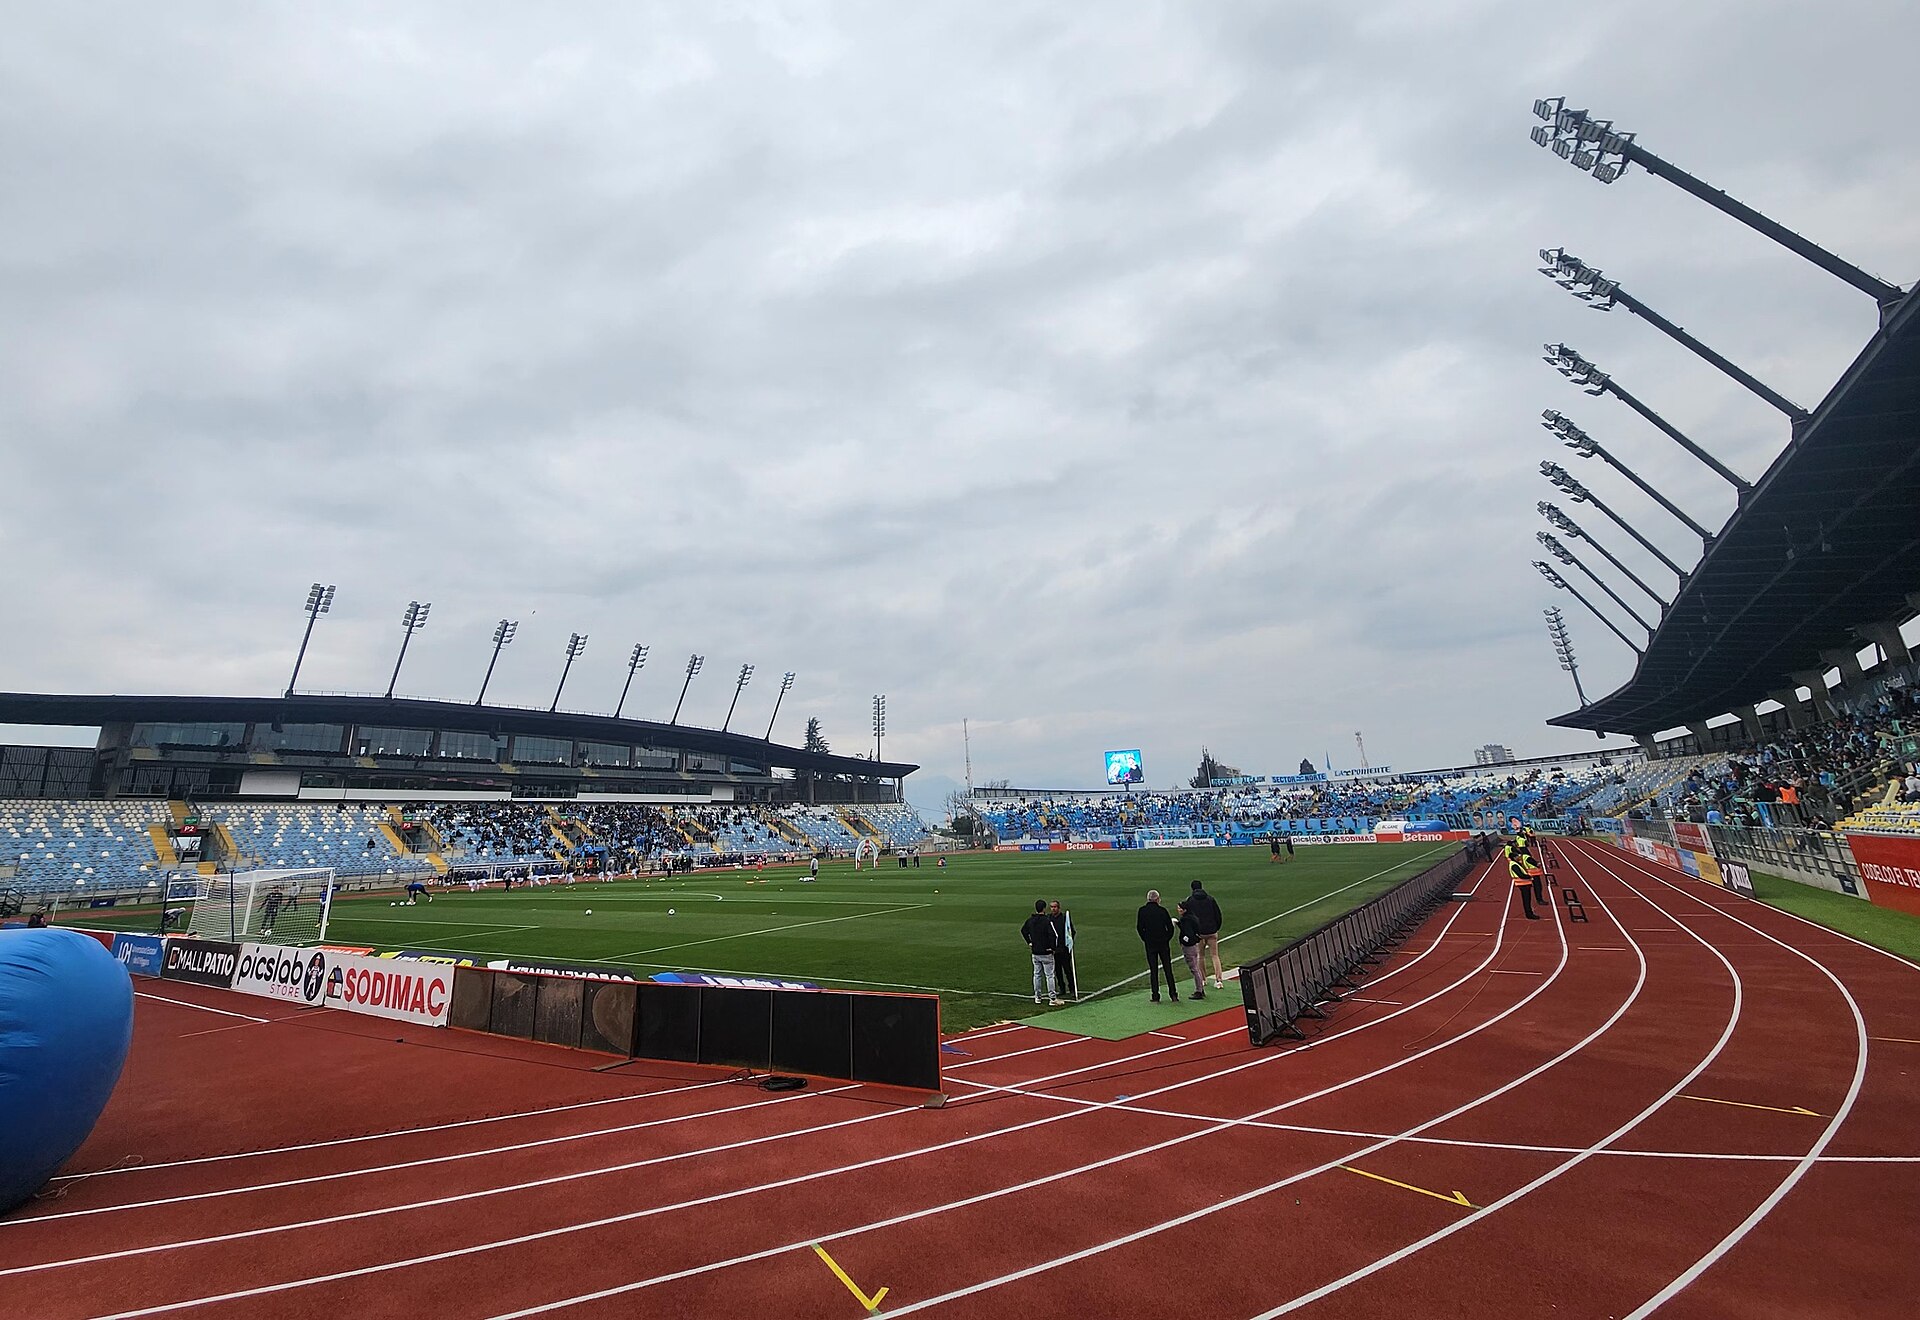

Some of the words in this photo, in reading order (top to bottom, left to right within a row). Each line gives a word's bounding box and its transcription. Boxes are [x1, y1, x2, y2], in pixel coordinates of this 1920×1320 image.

[1293, 835, 1322, 845] picslab
[1340, 835, 1376, 843] SODIMAC
[1403, 833, 1443, 842] Betano
[1862, 863, 1896, 884] CODELCO
[237, 946, 304, 985] picslab
[269, 983, 300, 997] STORE
[344, 967, 445, 1016] SODIMAC
